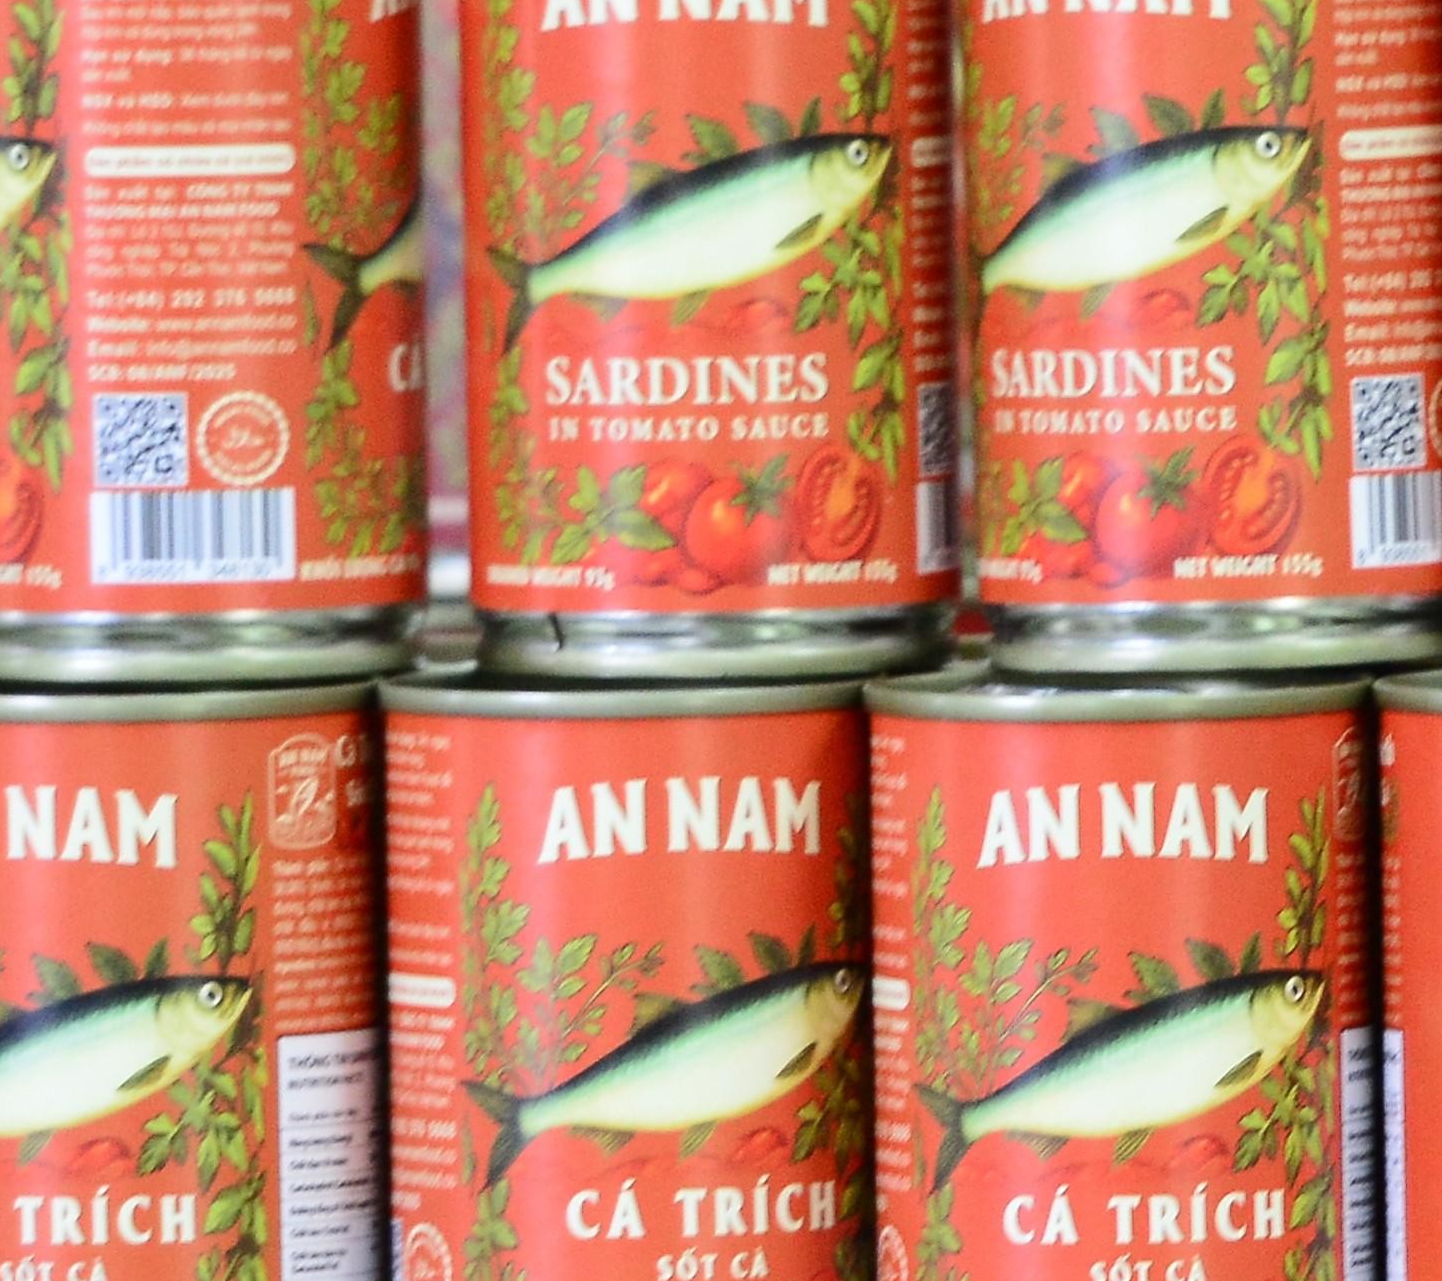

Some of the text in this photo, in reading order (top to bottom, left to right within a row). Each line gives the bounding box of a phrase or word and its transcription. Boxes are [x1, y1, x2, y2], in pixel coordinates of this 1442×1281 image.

[544, 353, 830, 406] SARDINES
[990, 345, 1236, 401] SARDINES
[549, 412, 830, 443] IN TOMATO SAUCE
[993, 404, 1238, 435] IN TOMATO SAUCE
[1173, 558, 1208, 580] NET
[1210, 556, 1277, 580] WEIGHT
[5, 785, 179, 869] NAM
[539, 778, 822, 864] AN NAM
[977, 782, 1270, 868] AN NAM
[14, 1184, 198, 1245] TRÍCH
[564, 1171, 837, 1241] CÁ TRÍCH
[1001, 1182, 1287, 1245] CÁ TRÍCH
